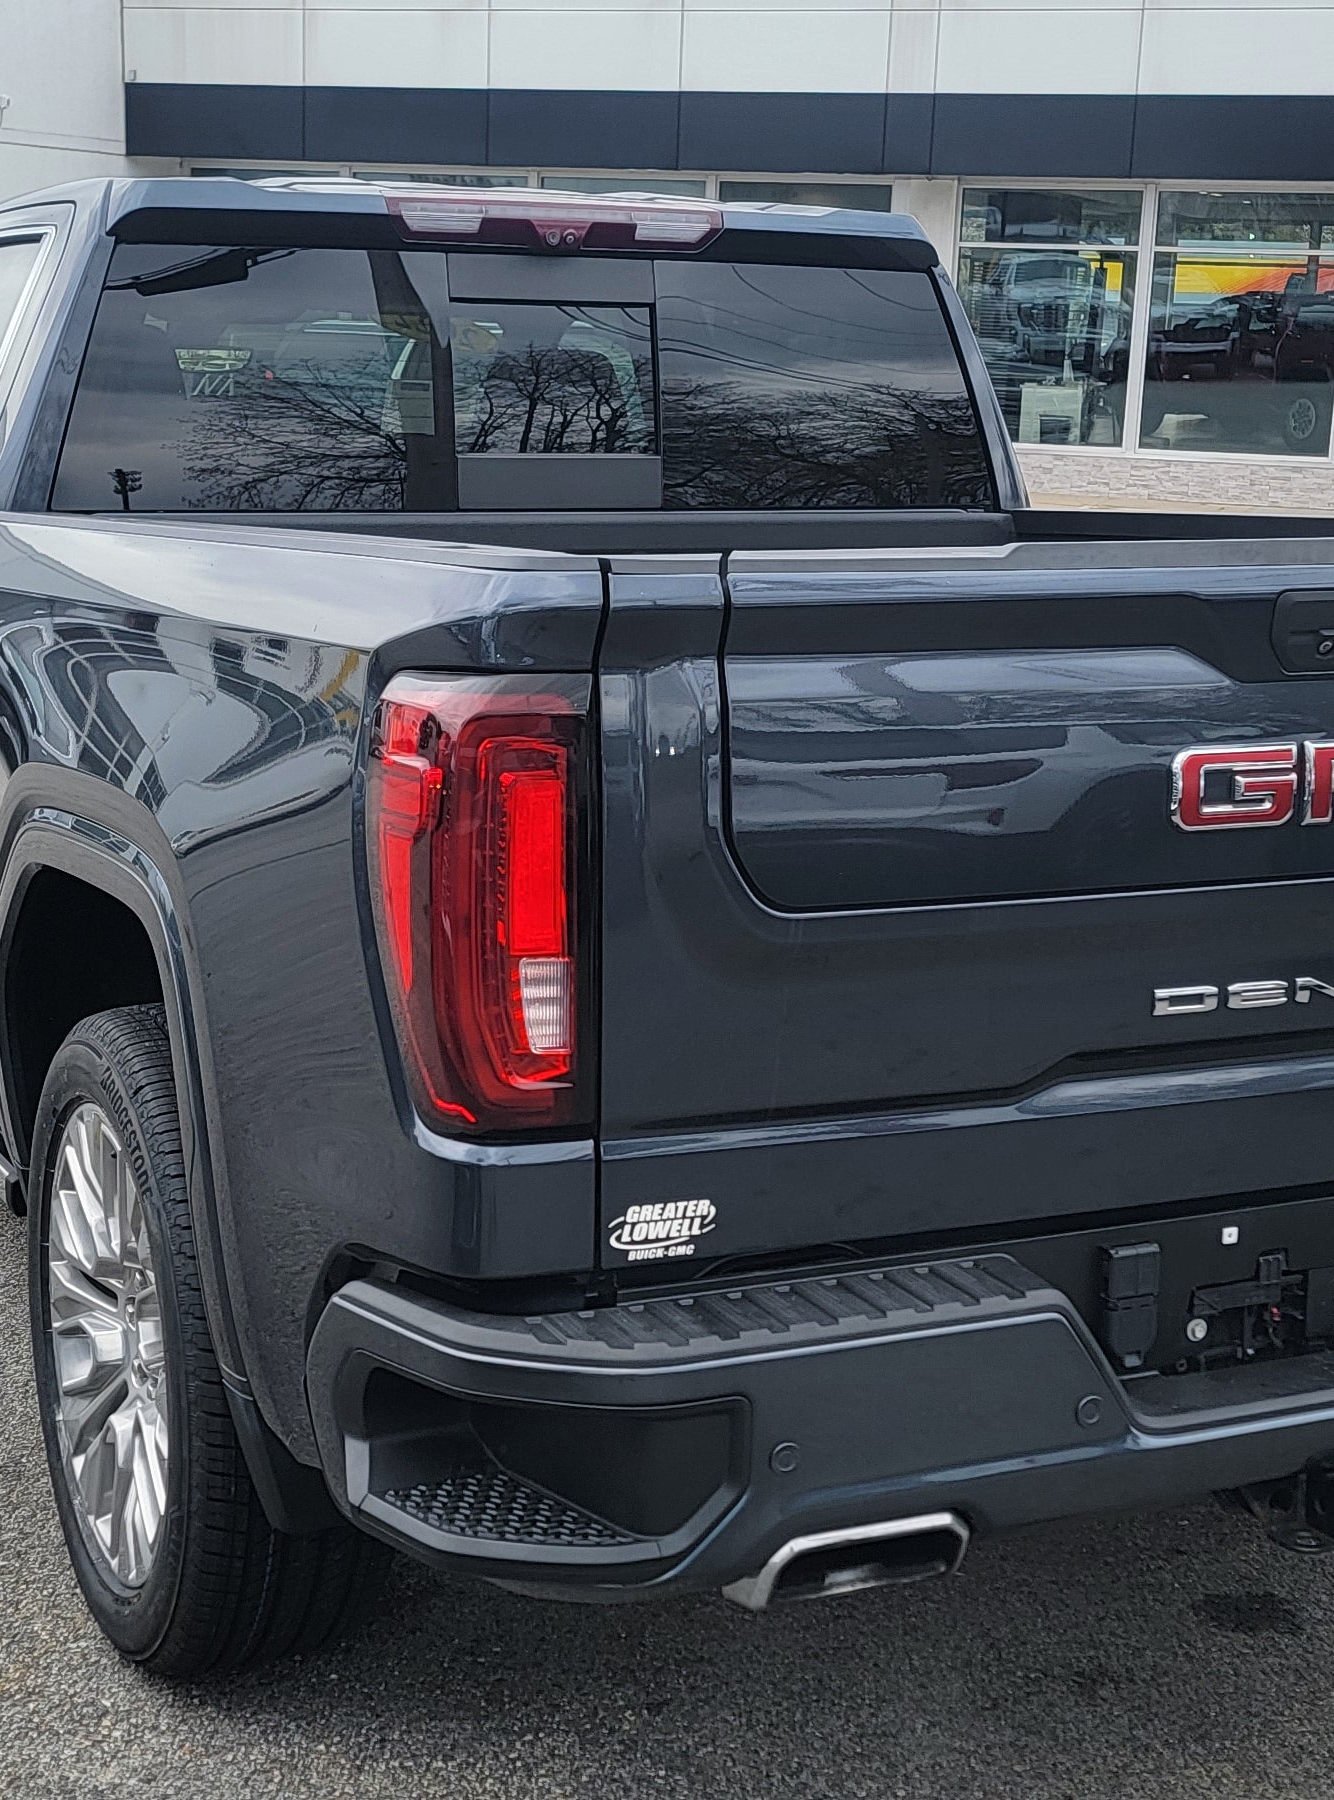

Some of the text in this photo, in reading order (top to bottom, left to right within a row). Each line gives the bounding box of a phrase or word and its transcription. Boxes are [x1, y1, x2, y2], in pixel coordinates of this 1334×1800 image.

[100, 1065, 154, 1203] BRIDGESTONE
[625, 1199, 711, 1224] GREATER
[620, 1217, 702, 1243] LOWELL
[627, 1243, 696, 1262] BUICK-GMC
